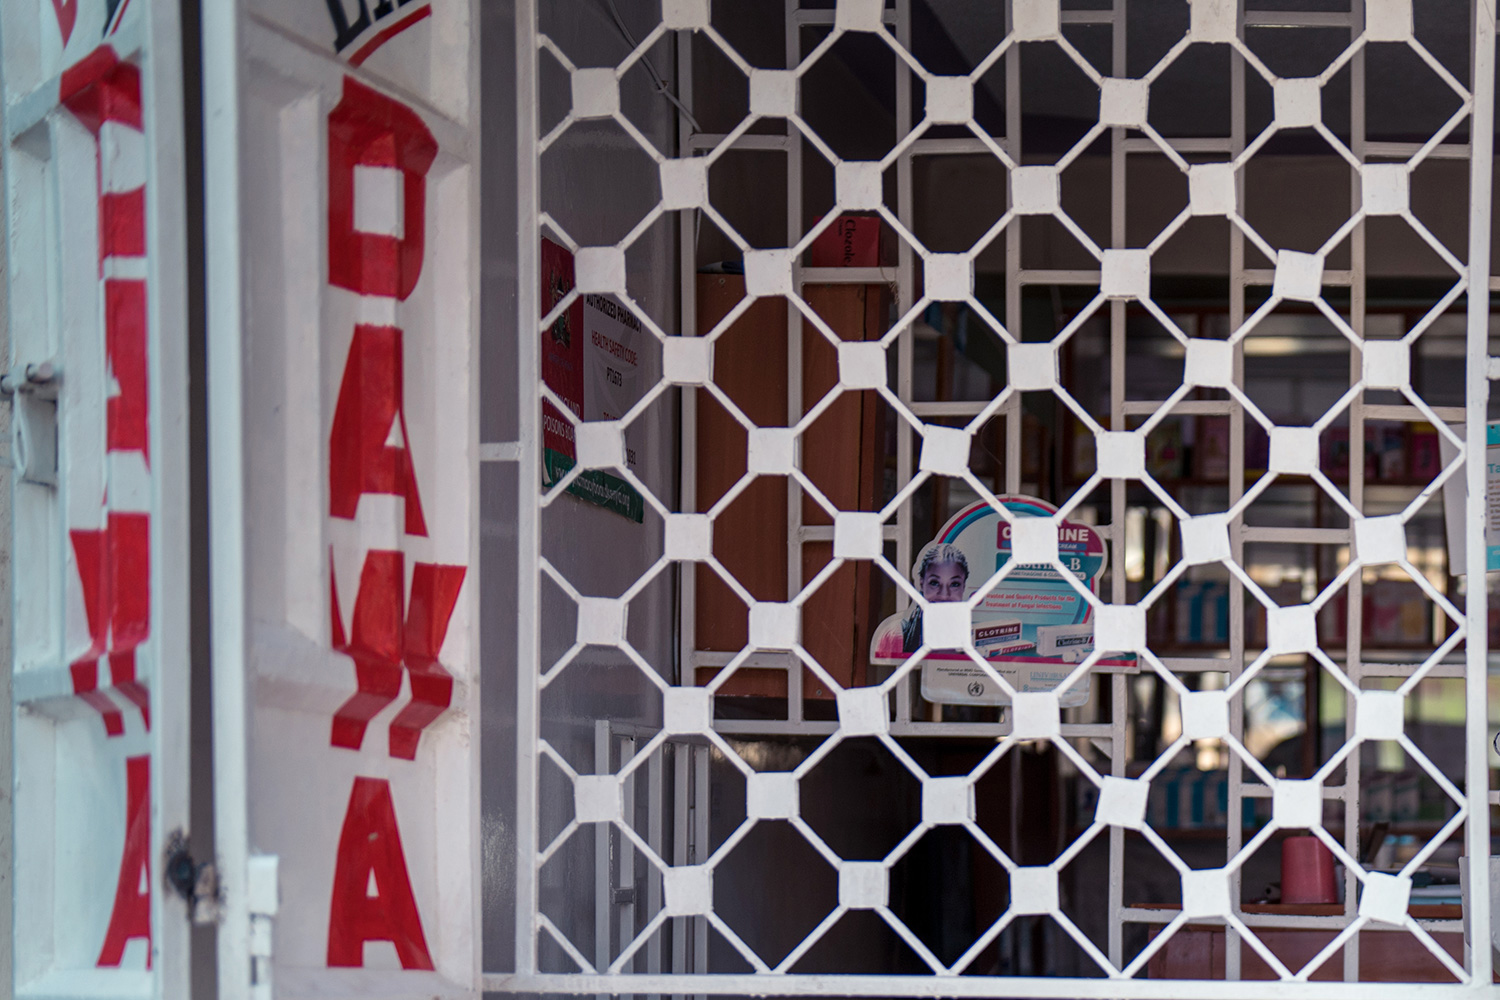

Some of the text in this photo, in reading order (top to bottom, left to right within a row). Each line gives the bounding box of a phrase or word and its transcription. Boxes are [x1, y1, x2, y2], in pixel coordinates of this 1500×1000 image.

[844, 219, 856, 263] Clozole
[591, 329, 608, 352] HEALTH
[609, 339, 624, 362] SAFETY
[978, 626, 1018, 637] CLOTRINE
